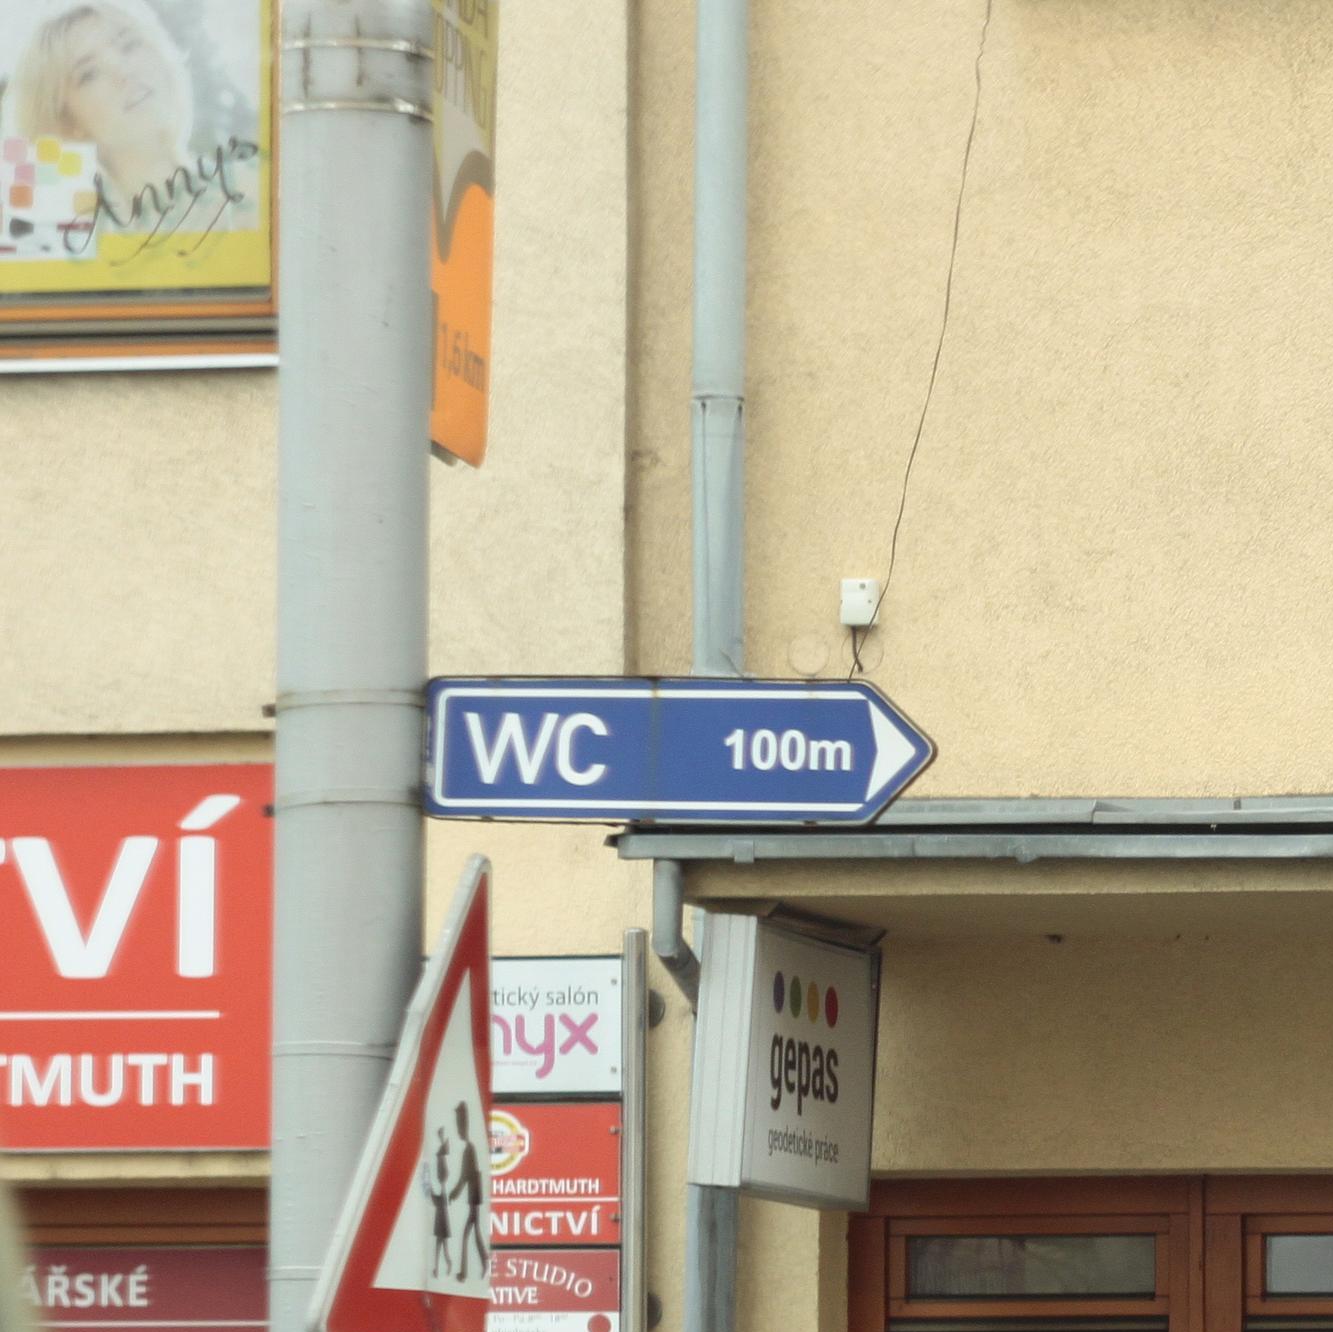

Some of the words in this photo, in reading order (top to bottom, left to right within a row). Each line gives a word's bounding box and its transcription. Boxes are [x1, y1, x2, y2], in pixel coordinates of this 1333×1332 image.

[464, 711, 608, 786] WC
[724, 728, 853, 772] 100m
[0, 794, 241, 979] VÍ
[492, 984, 540, 1011] tický
[545, 985, 600, 1006] salón
[491, 1012, 599, 1080] nyx
[770, 1032, 839, 1117] gepas
[767, 1126, 814, 1159] geodetické
[814, 1135, 839, 1166] práce
[493, 1177, 600, 1196] HARDTMUTH
[490, 1205, 601, 1237] NICTVÍ
[21, 1263, 149, 1308] ÁŘSKÉ
[489, 1286, 539, 1305] ATIVE
[504, 1258, 593, 1298] STUDIO
